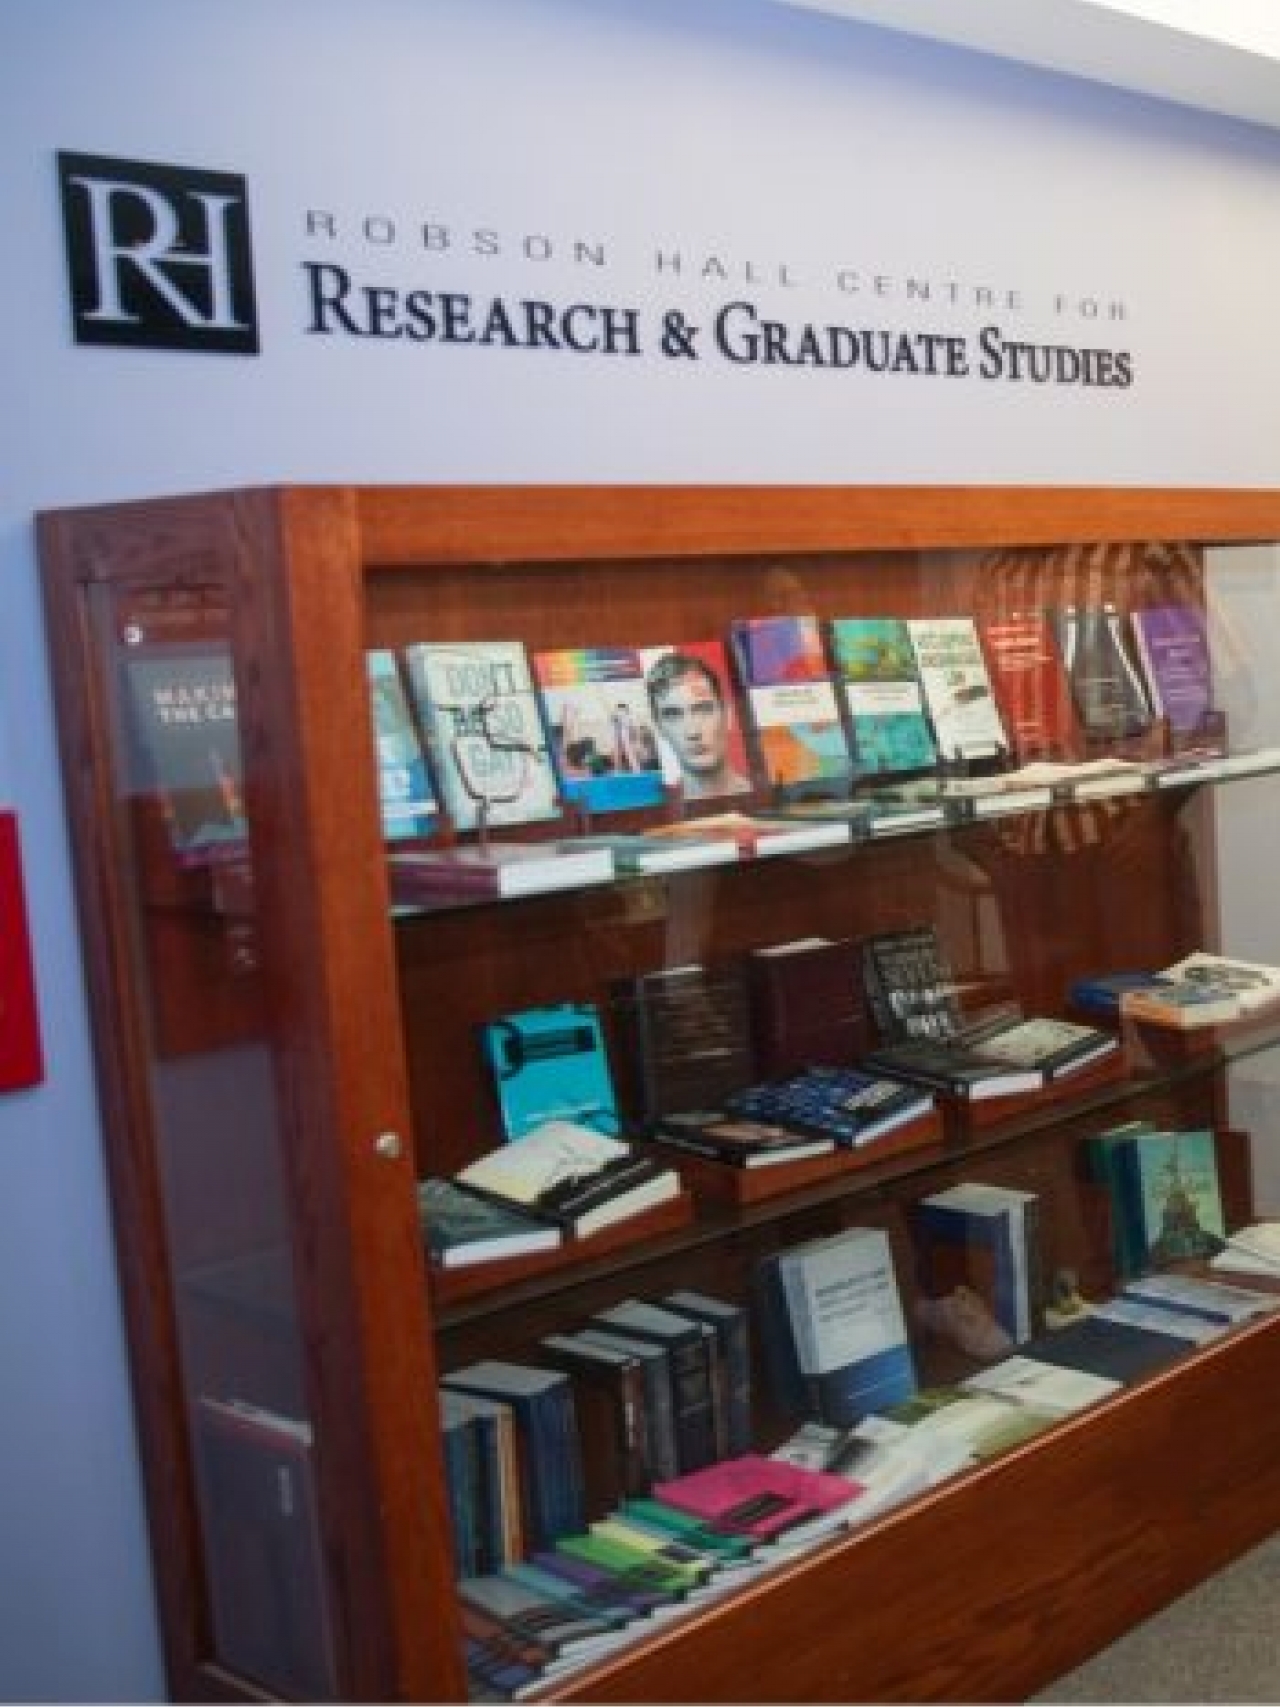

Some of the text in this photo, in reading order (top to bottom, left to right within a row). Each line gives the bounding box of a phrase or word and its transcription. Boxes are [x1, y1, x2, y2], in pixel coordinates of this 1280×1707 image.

[68, 175, 249, 331] RH
[304, 208, 1128, 322] ROBSON HALL CENTRE FOR
[301, 261, 1135, 390] RESEARCH & GRADUATE STUDIES
